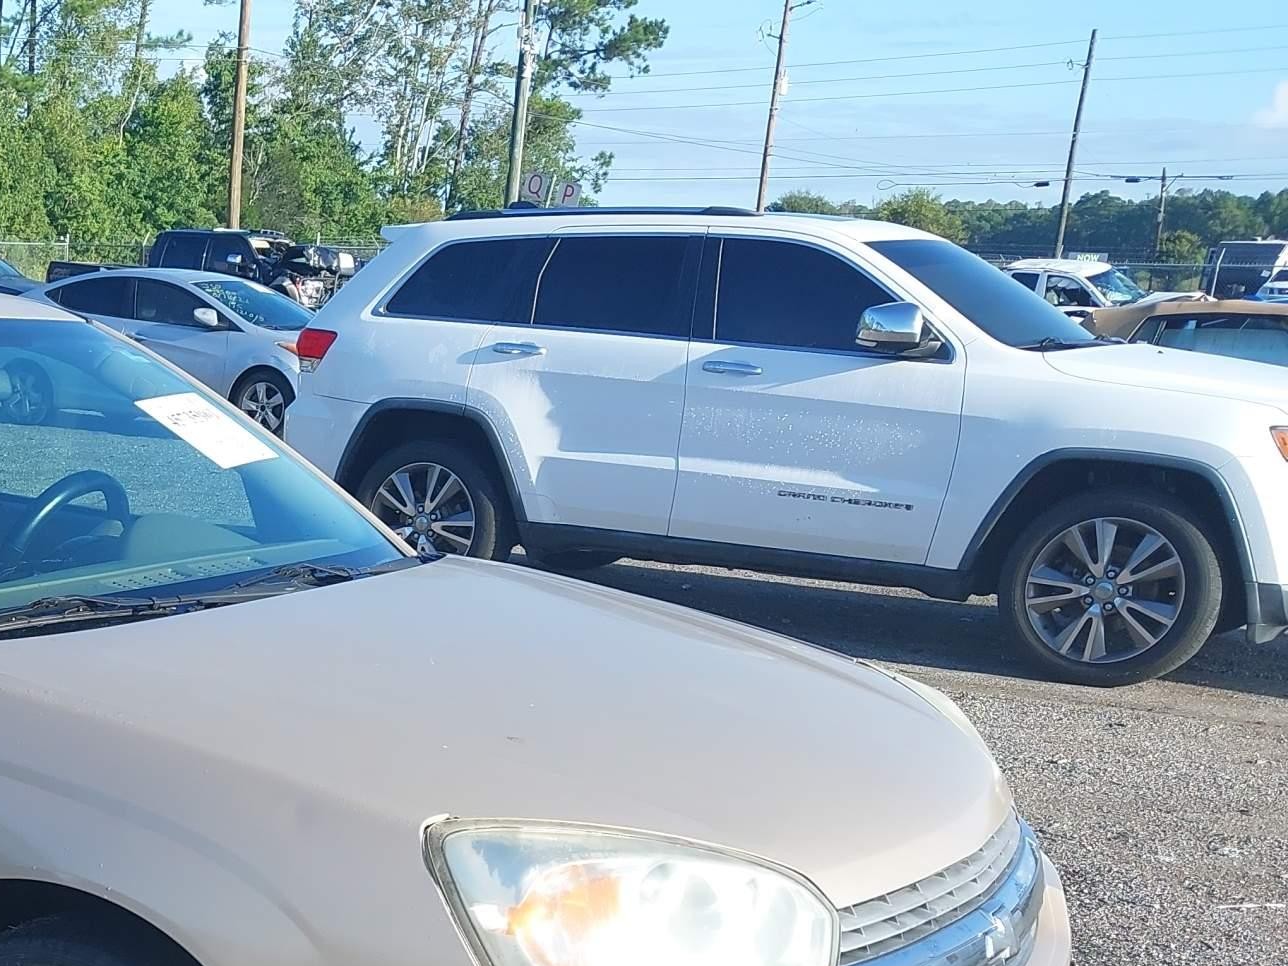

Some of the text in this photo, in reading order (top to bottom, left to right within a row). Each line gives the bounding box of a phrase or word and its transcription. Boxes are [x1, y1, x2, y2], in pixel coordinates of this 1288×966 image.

[528, 174, 542, 198] Q
[561, 184, 575, 204] P
[1076, 254, 1100, 262] NOW
[777, 490, 828, 501] GRAND
